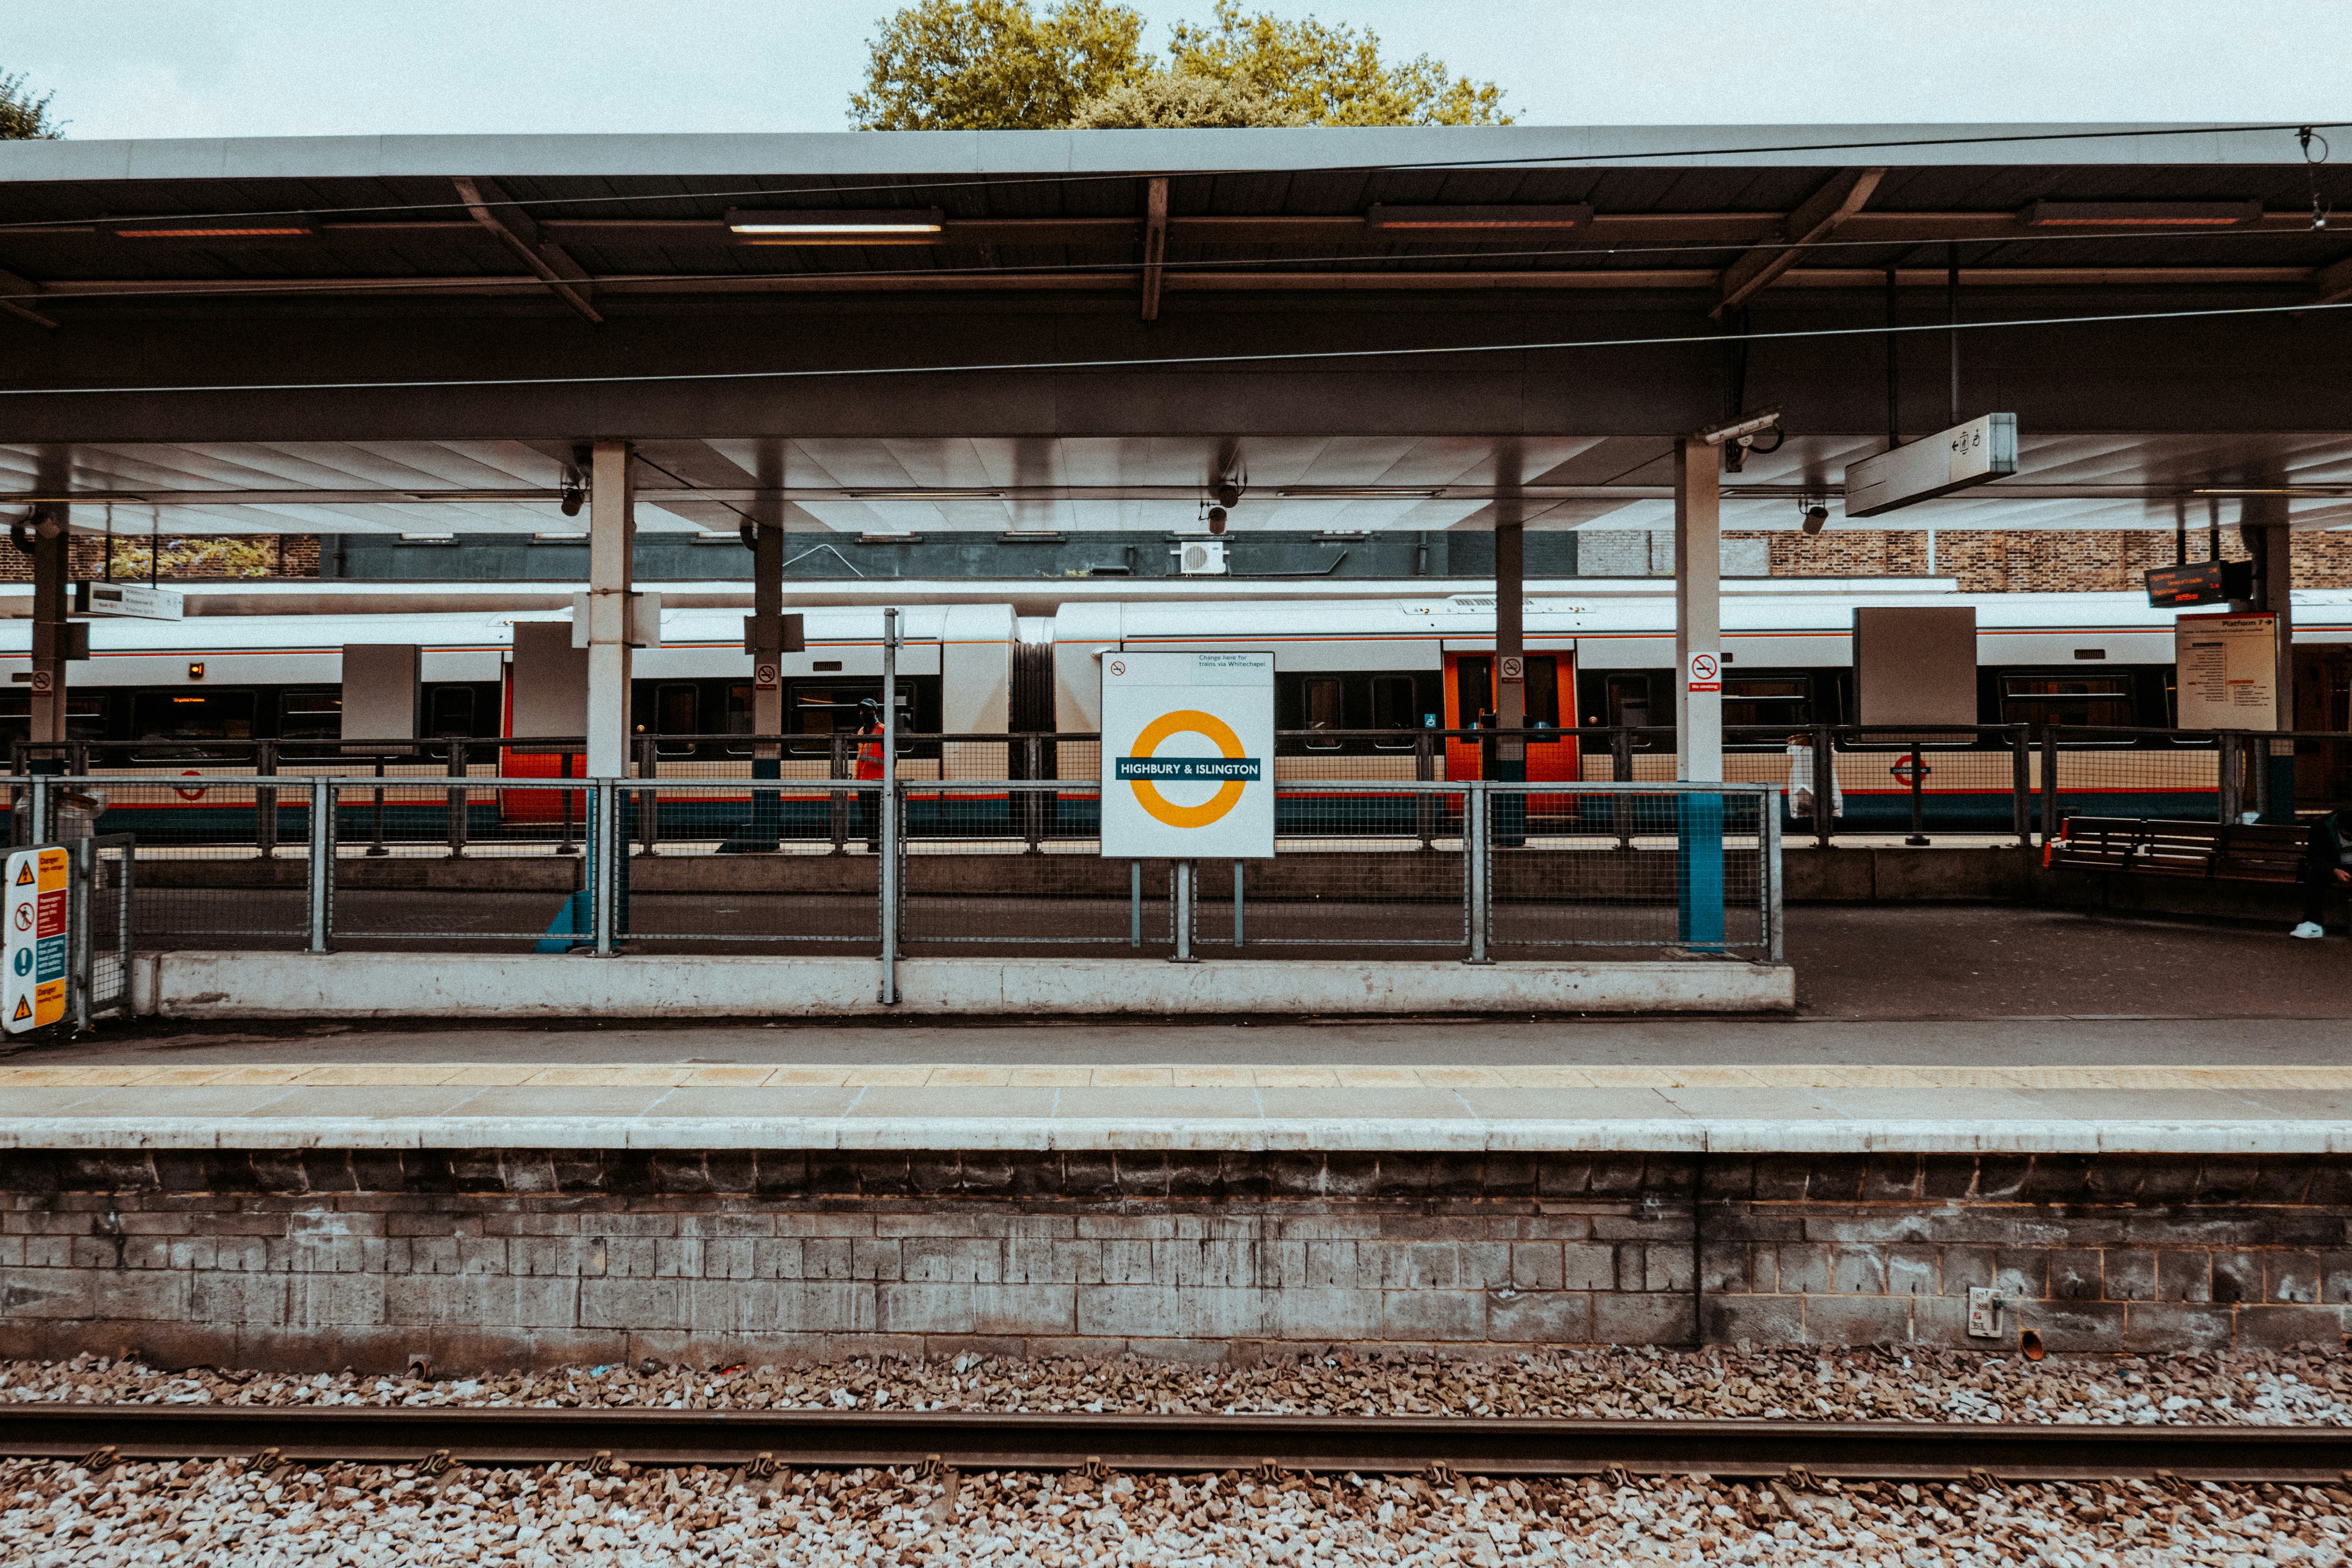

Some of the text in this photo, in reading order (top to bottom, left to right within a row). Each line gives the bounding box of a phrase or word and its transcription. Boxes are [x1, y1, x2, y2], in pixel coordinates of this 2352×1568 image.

[1121, 764, 1258, 774] HIGHBURY & ISLINGTON
[38, 987, 57, 996] Danger
